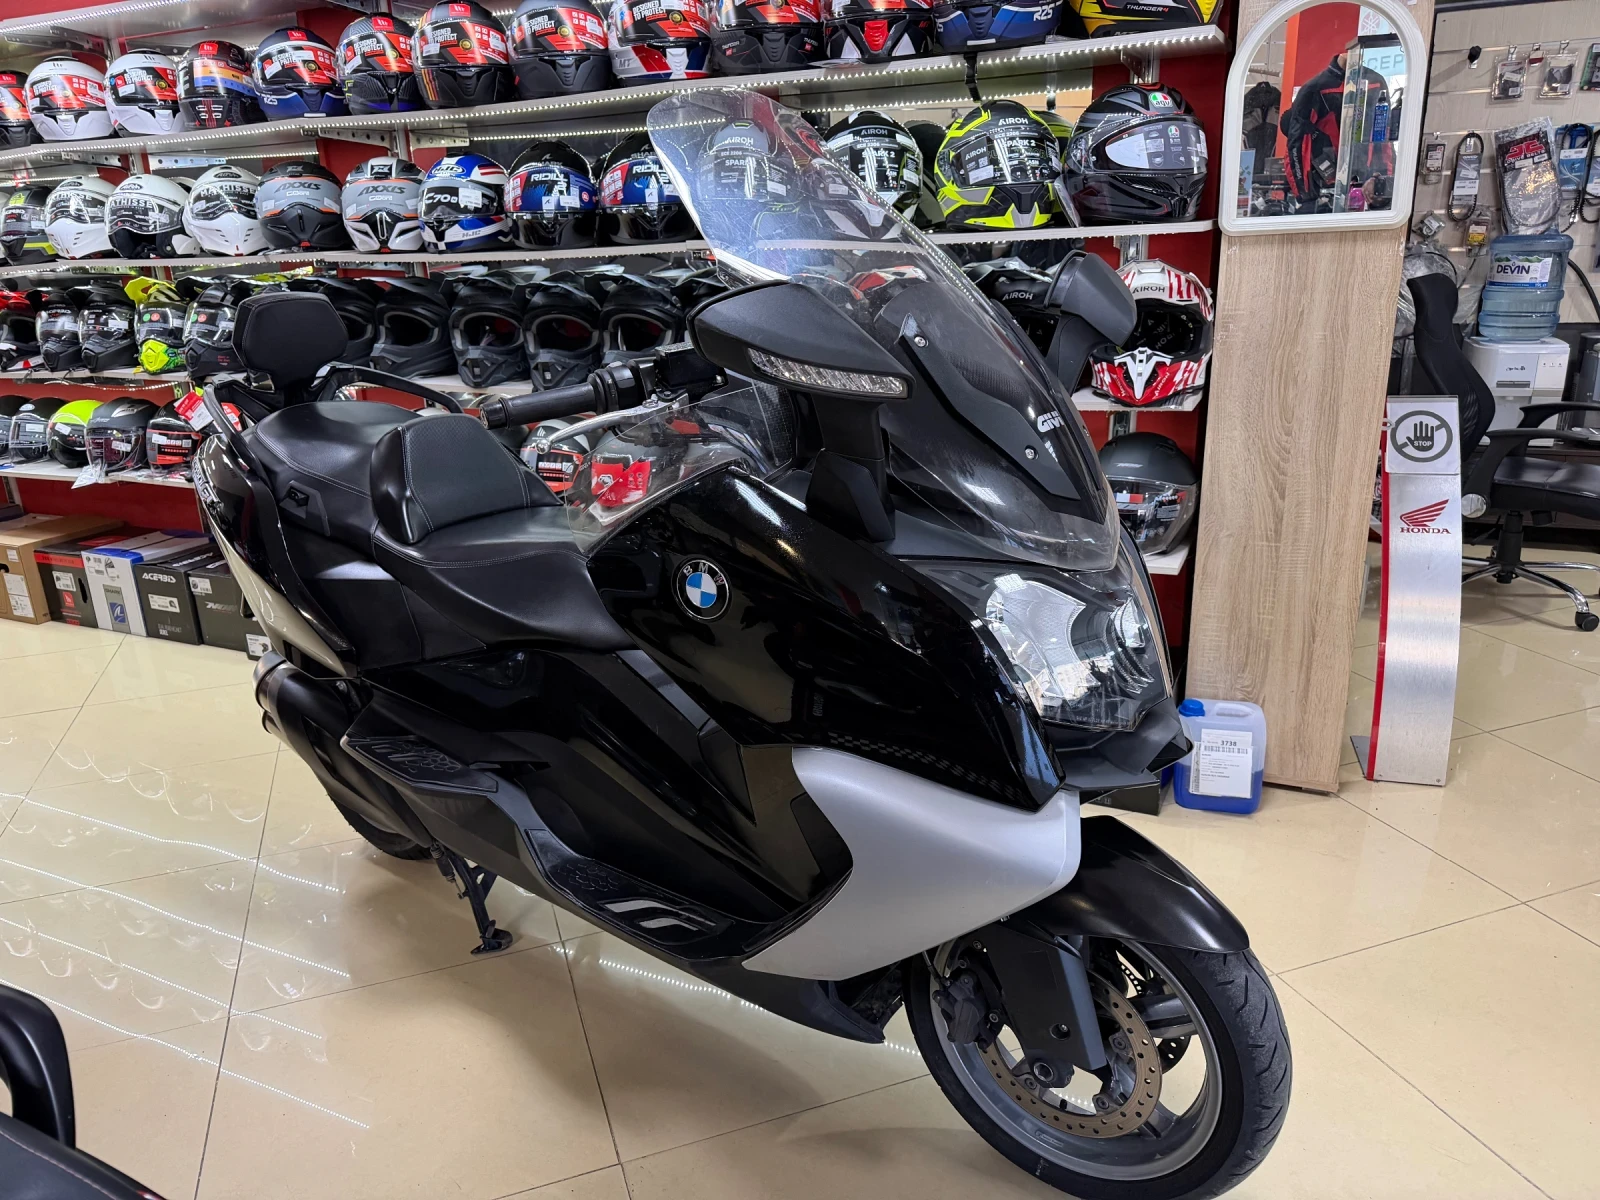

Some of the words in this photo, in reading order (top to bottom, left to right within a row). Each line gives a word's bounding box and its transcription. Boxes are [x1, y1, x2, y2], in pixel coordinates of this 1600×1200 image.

[632, 1, 660, 14] DESIGNED
[634, 13, 641, 21] TO
[531, 20, 556, 32] PROTECT
[619, 59, 632, 68] MT
[998, 118, 1028, 126] AIROH
[725, 136, 754, 145] AIROH
[966, 146, 986, 160] AIROH
[274, 182, 322, 194] AXXIS
[357, 185, 406, 197] AXXIS
[109, 198, 154, 210] ATHISSE
[462, 230, 482, 238] HJC
[1496, 264, 1530, 274] DEVIN
[1132, 286, 1166, 294] AIROH
[1002, 292, 1034, 300] AIROH
[142, 572, 176, 583] ACERBIS
[682, 562, 725, 586] BMW
